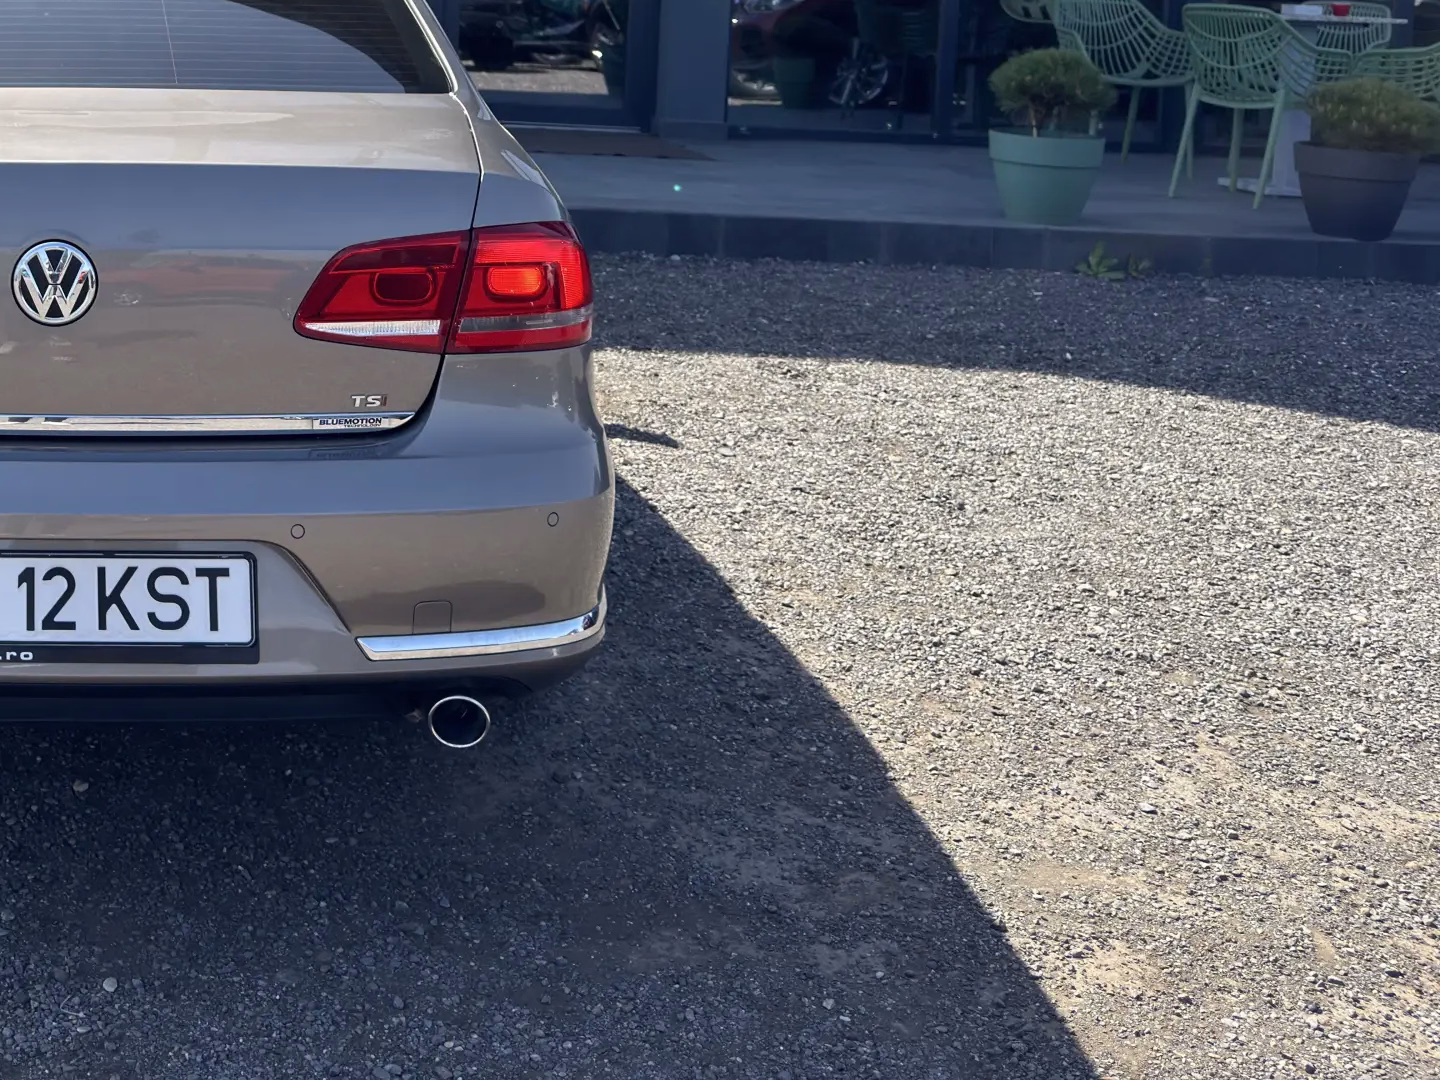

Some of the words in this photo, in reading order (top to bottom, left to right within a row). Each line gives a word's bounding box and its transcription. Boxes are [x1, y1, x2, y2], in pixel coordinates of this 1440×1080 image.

[14, 241, 96, 324] VW
[319, 418, 382, 426] BLUEMOTION
[17, 567, 77, 632] 12
[97, 566, 230, 632] KST
